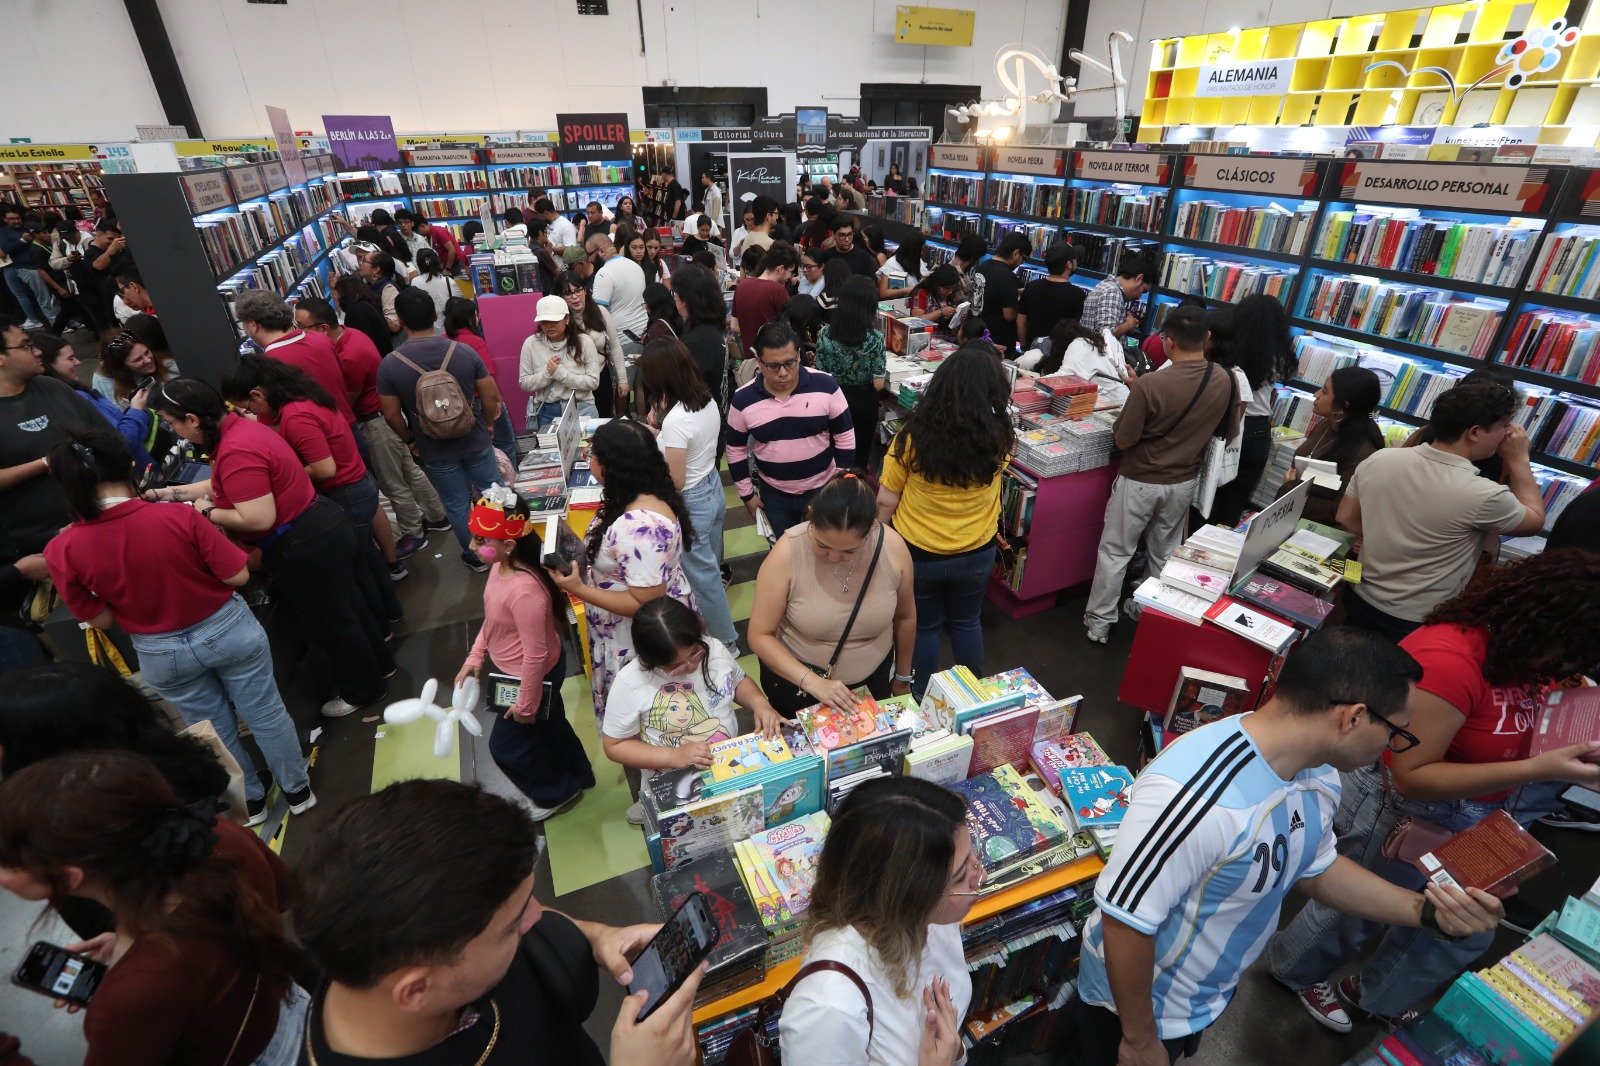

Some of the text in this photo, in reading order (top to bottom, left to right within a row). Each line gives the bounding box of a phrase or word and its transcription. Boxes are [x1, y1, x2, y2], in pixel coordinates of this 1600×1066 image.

[1208, 66, 1278, 84] ALEMANIA
[1219, 84, 1244, 92] INVITADO
[1244, 83, 1253, 91] DE
[1253, 82, 1276, 91] HONOR
[329, 128, 358, 141] BERLÍN
[358, 131, 365, 140] A
[365, 130, 379, 140] LAS
[563, 124, 625, 144] SPOILER
[655, 131, 670, 140] 140
[713, 130, 784, 139] Editorial Cultura
[829, 130, 837, 138] La
[854, 130, 880, 138] nacional
[882, 130, 889, 138] de
[890, 130, 896, 138] la
[897, 130, 927, 138] literatura
[15, 149, 27, 158] La
[30, 148, 65, 158] Estella
[106, 146, 130, 157] 143
[1007, 156, 1044, 165] NOVELA NEGRA
[1088, 161, 1150, 173] NOVELA DE TERROR
[1216, 167, 1276, 185] CLÁSICOS
[1364, 176, 1510, 196] DESARROLLO PERSONAL
